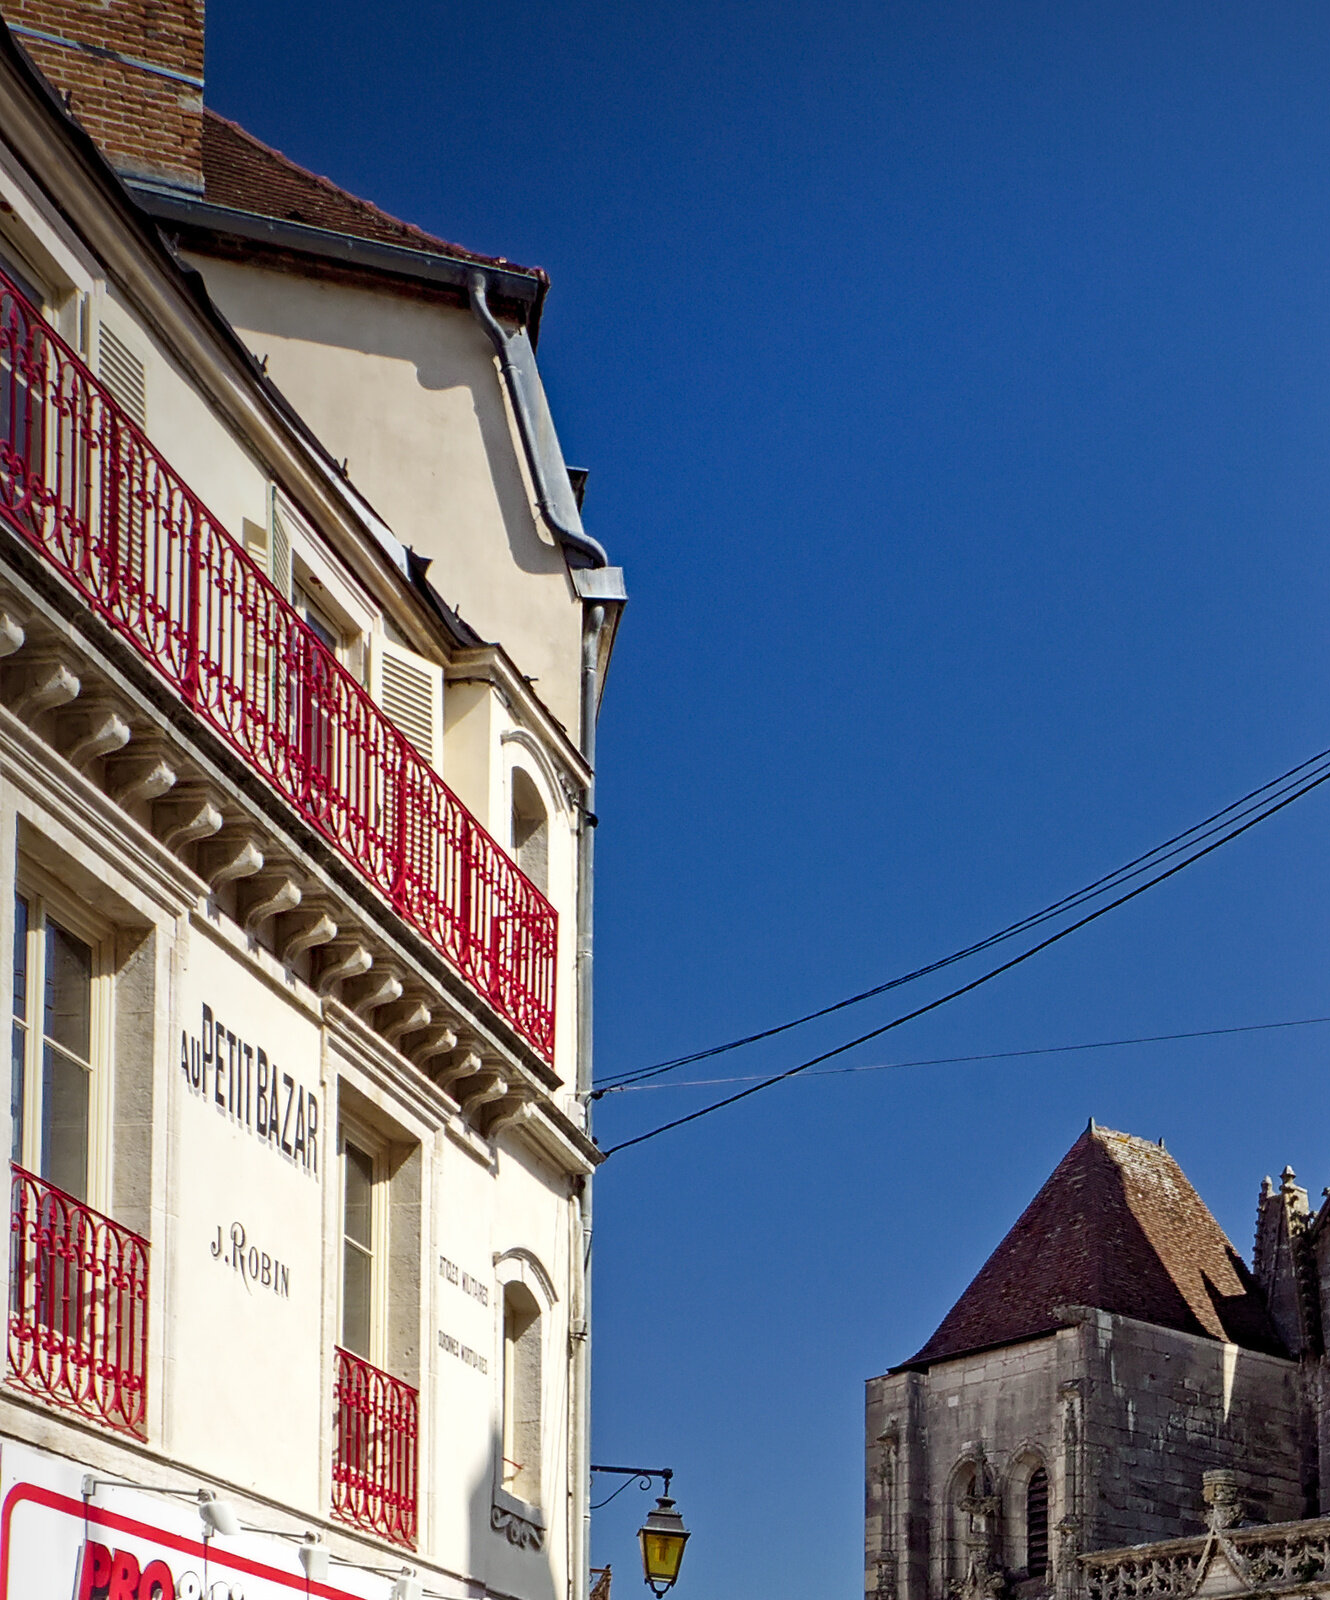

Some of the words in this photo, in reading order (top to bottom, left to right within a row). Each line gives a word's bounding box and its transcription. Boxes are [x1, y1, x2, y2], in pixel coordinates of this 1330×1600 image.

[181, 1029, 200, 1089] AU
[202, 1001, 253, 1126] PETIT
[256, 1045, 318, 1174] BAZAR
